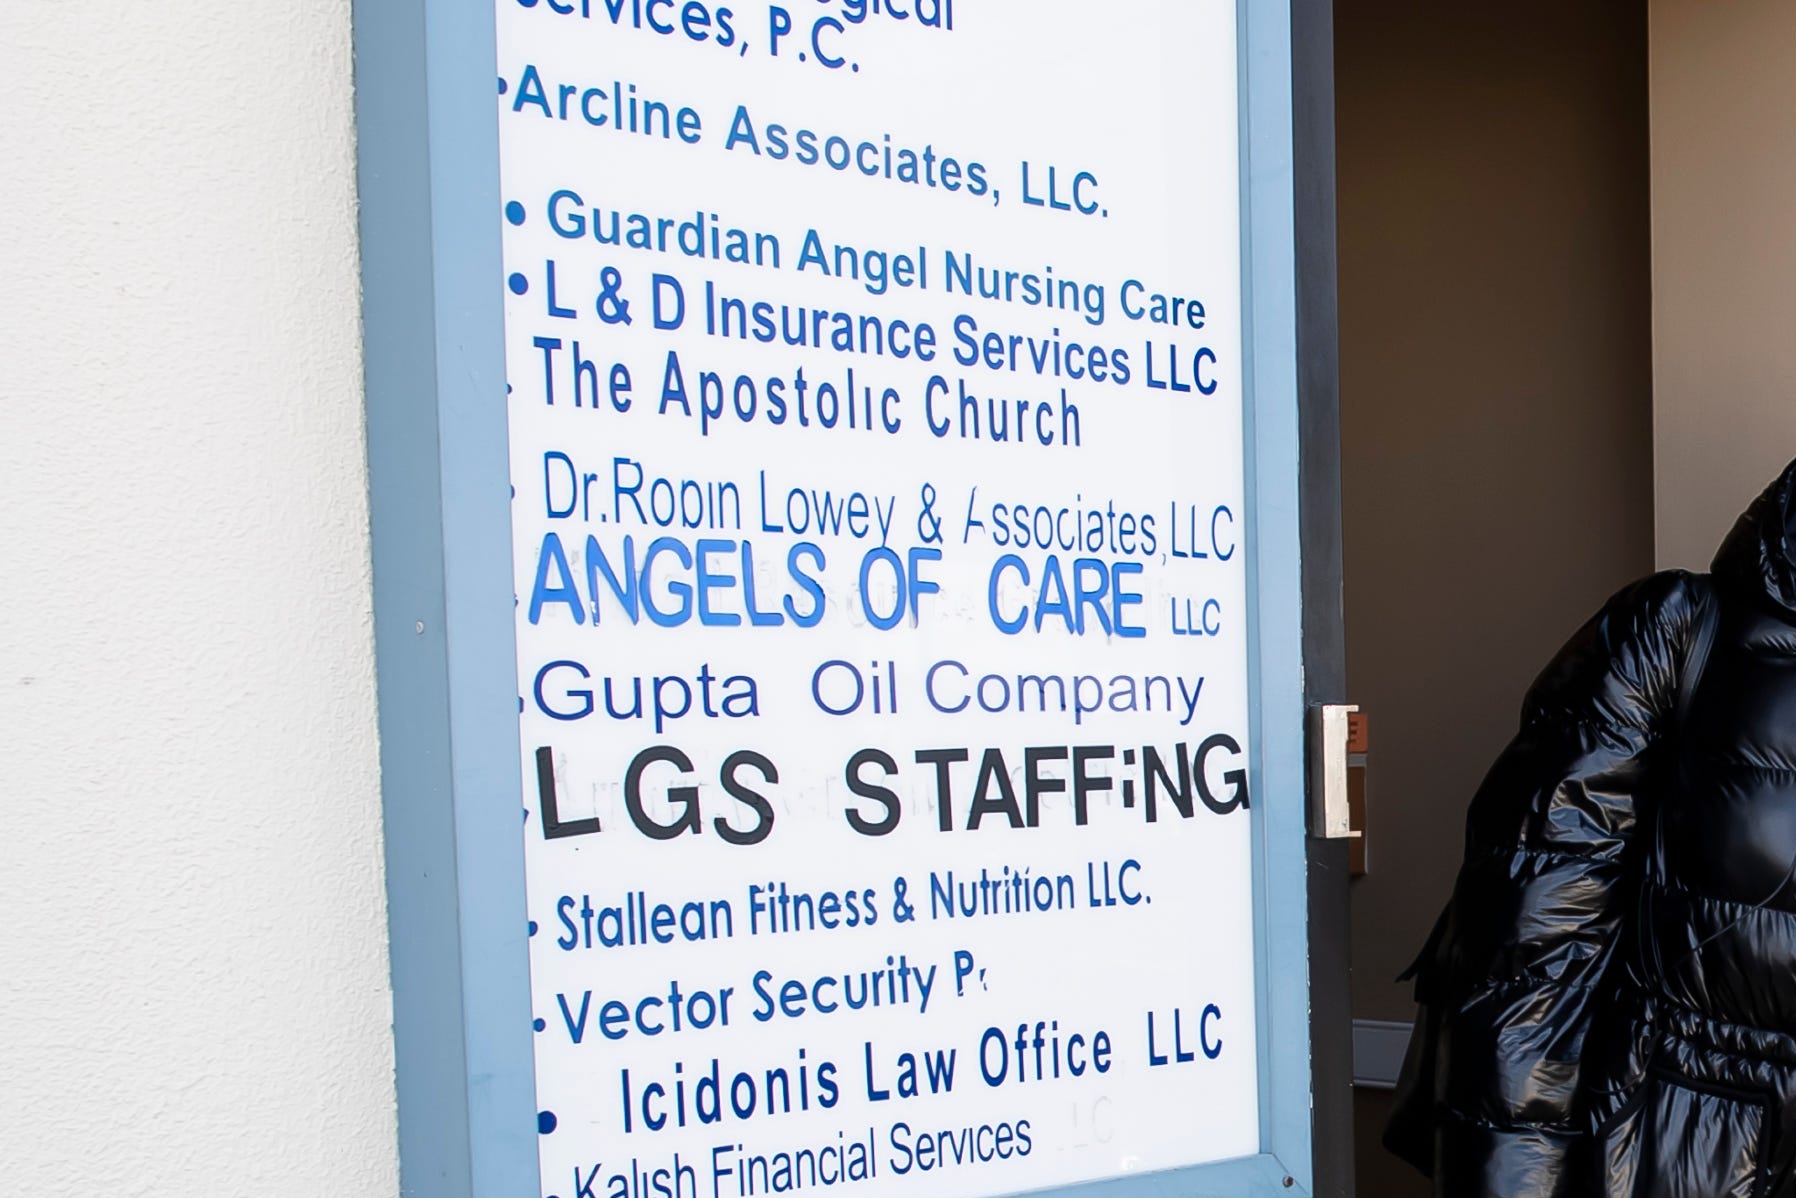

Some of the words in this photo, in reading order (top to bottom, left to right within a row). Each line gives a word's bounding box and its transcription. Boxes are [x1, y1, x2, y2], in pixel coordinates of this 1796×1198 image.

[516, 0, 748, 57] vices,
[769, 5, 858, 72] P.C.
[512, 64, 701, 144] Arcline
[725, 105, 999, 207] Associates,
[1022, 161, 1107, 217] LLC.
[547, 189, 779, 268] Guardian
[797, 229, 926, 295] Angel
[945, 250, 1104, 325] Nursing
[1120, 279, 1205, 329] Care
[546, 259, 577, 319] L
[596, 266, 632, 326] &
[652, 273, 685, 330] D
[706, 281, 936, 361] Insurance
[953, 314, 1130, 385] Services
[1146, 341, 1217, 395] LLC
[533, 336, 631, 413] The
[658, 350, 901, 436] Apostolic
[925, 375, 1080, 446] Church
[760, 470, 894, 552] Lowey
[918, 482, 943, 544] &
[528, 532, 825, 628] ANGELS
[858, 547, 942, 630] OF
[988, 554, 1146, 638] CARE
[1172, 597, 1220, 636] LLC
[533, 660, 759, 734] Gupta
[812, 660, 896, 715] Oil
[926, 660, 1204, 726] Company
[557, 891, 732, 951] Stallean
[749, 882, 877, 935] Fitness
[893, 877, 915, 923] &
[930, 866, 1074, 920] Nutrition
[1088, 859, 1151, 907] LLC.
[556, 981, 734, 1044] Vector
[752, 955, 936, 1022] Security
[865, 1042, 956, 1102] Law
[980, 1020, 1111, 1087] Office
[1148, 1003, 1222, 1066] LLC
[890, 1120, 1031, 1175] Services
